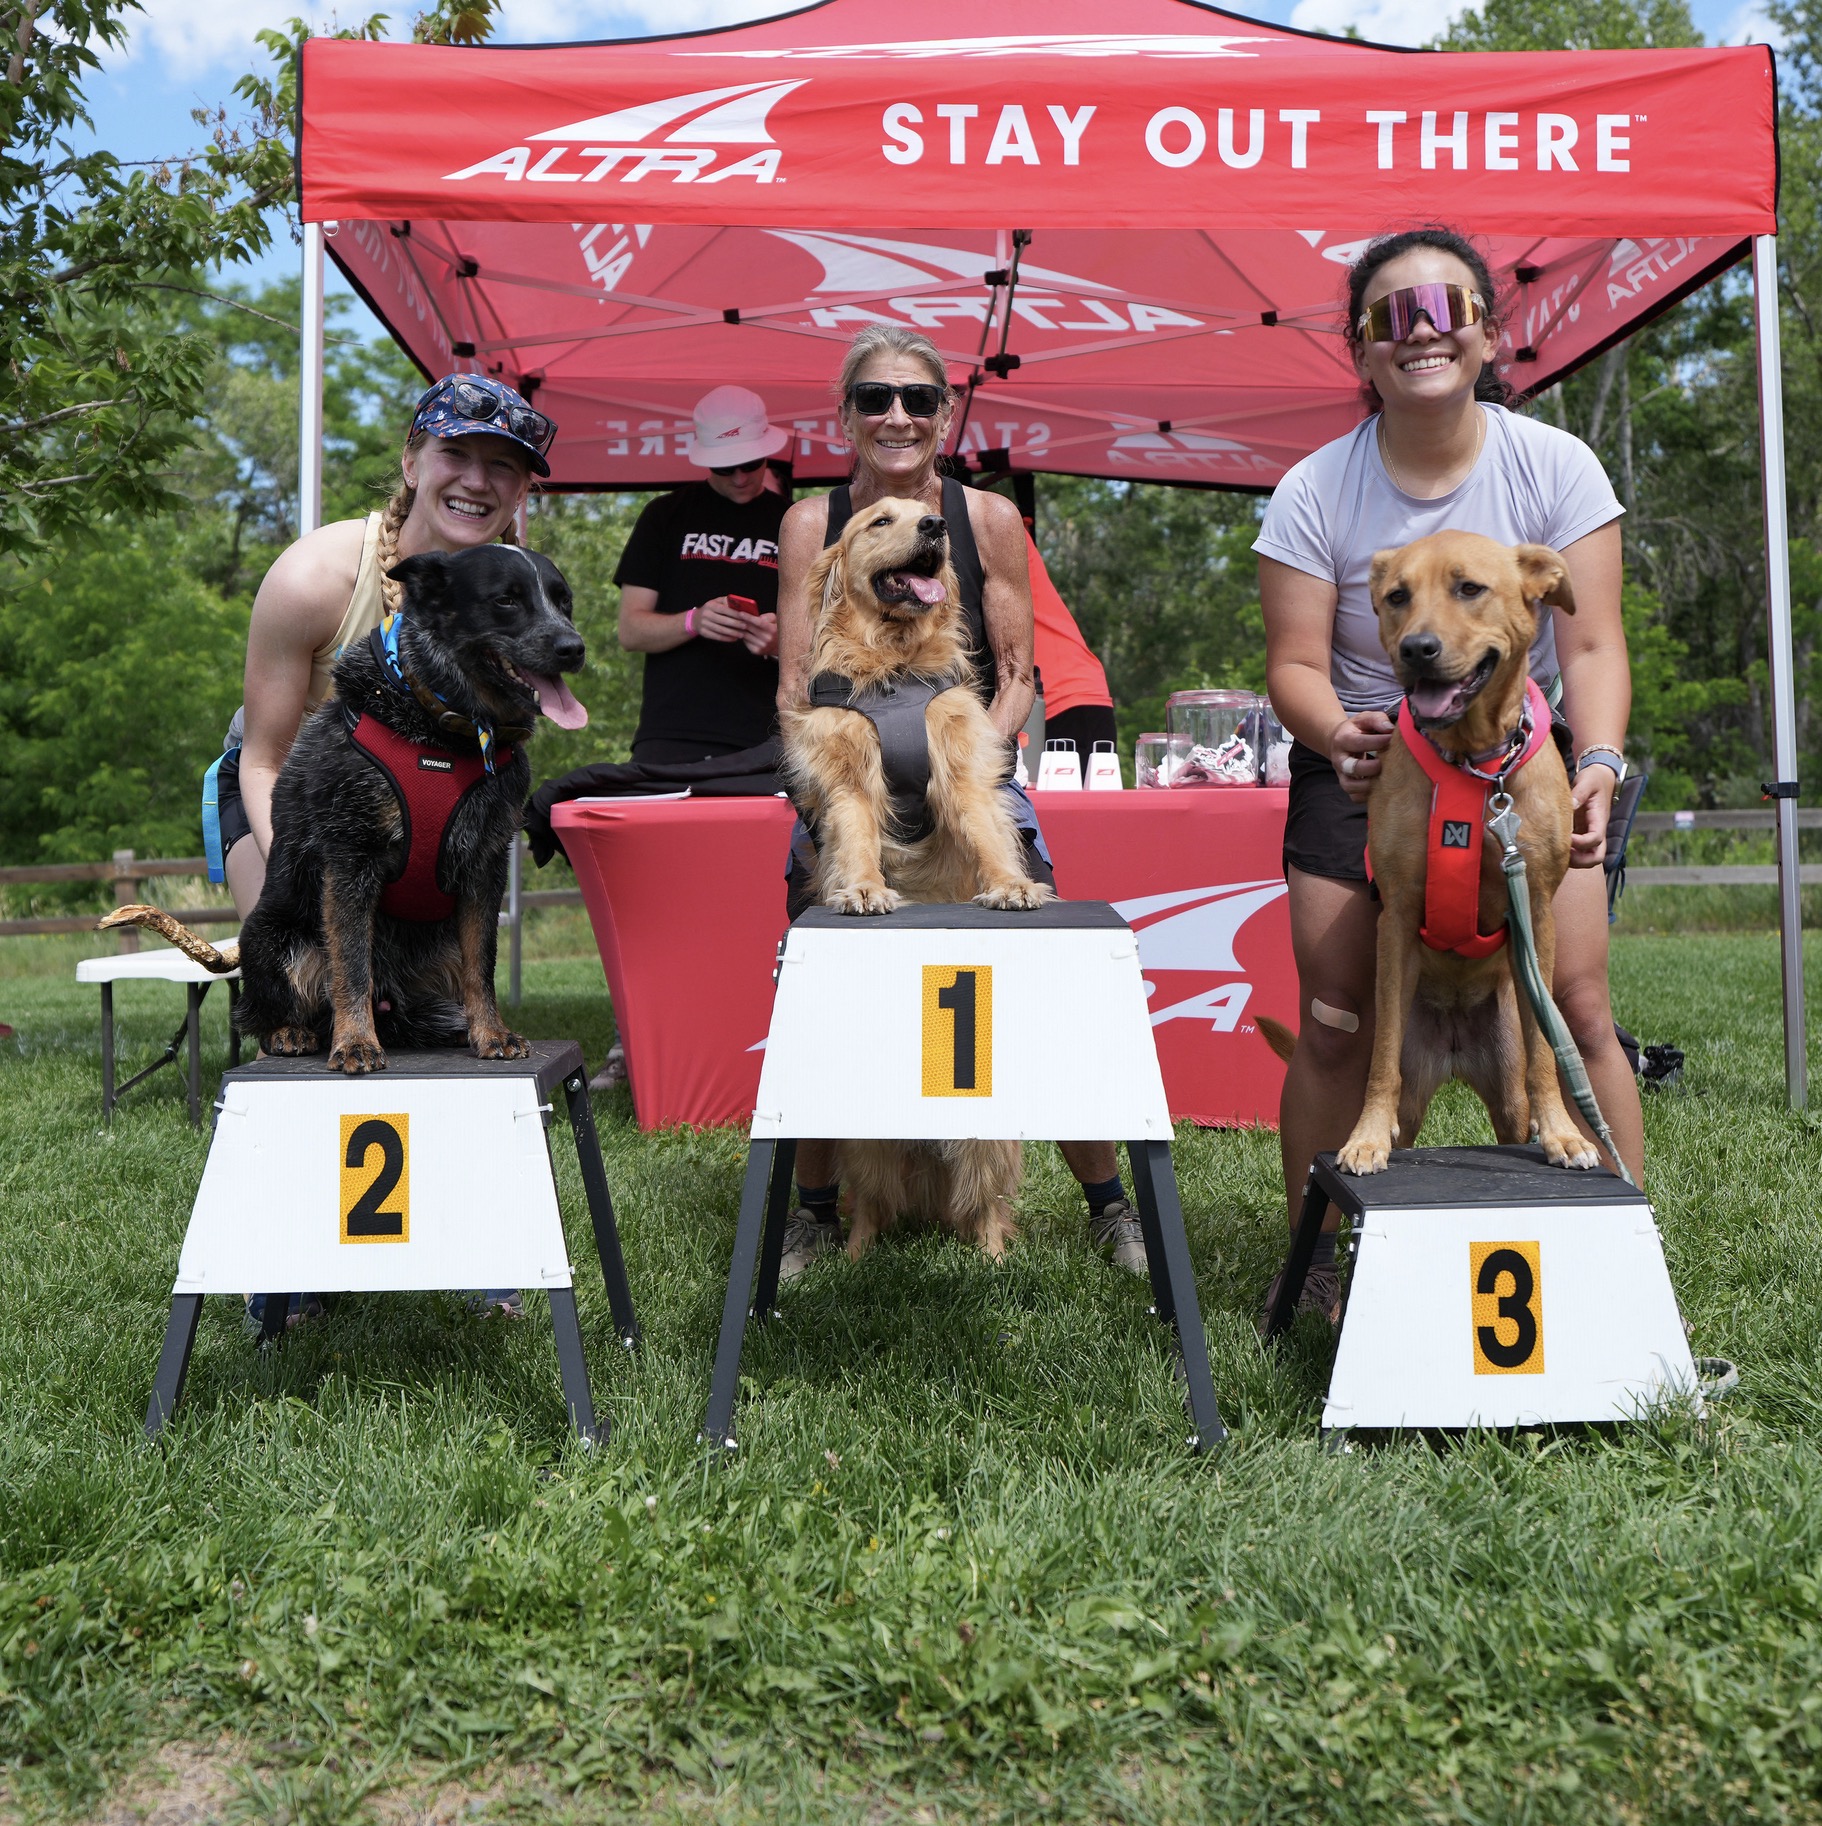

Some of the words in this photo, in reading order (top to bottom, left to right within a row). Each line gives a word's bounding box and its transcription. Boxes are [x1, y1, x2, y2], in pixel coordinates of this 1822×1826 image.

[441, 147, 782, 183] ALTRA
[881, 102, 1098, 166] STAY
[1144, 105, 1321, 170] OUT
[1365, 110, 1631, 173] THERE
[681, 532, 734, 558] FAST
[422, 758, 452, 769] VOYAGER
[939, 972, 976, 1089] 1
[346, 1120, 404, 1236] 2
[1477, 1249, 1537, 1367] 3
